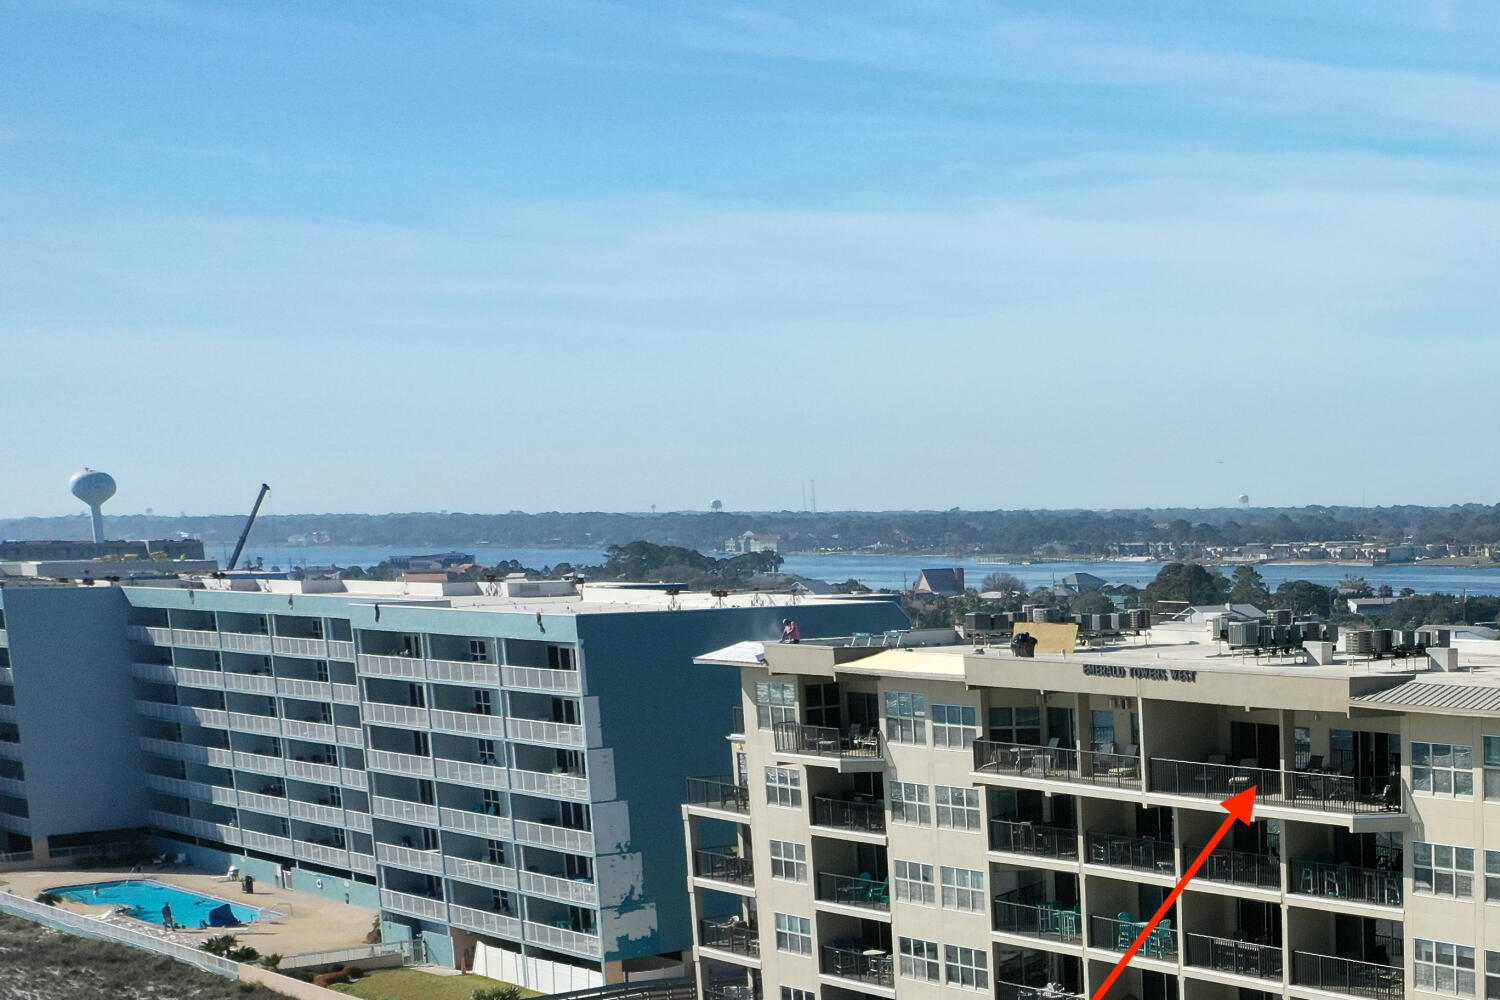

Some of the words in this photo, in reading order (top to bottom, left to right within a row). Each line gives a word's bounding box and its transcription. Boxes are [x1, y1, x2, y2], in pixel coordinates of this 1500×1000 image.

[1083, 664, 1126, 678] EMERALD
[1130, 667, 1168, 681] TOWERS
[1170, 670, 1197, 683] WEST
